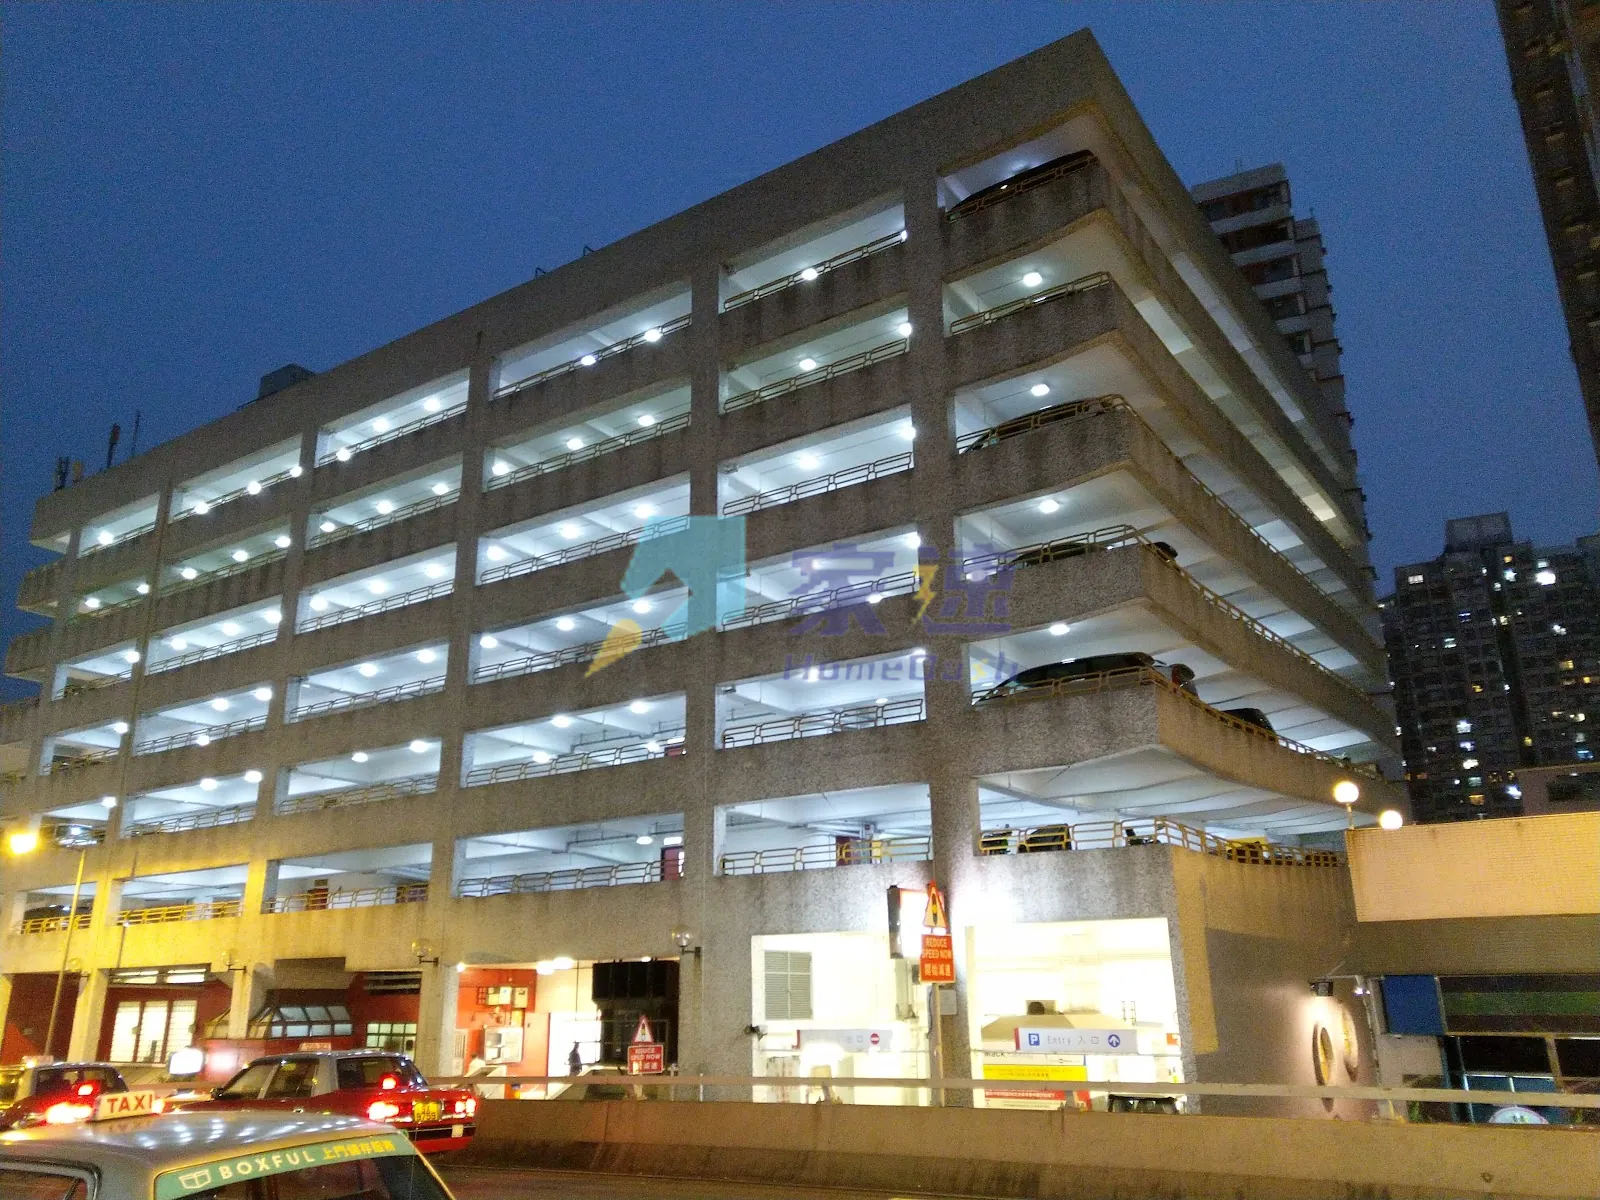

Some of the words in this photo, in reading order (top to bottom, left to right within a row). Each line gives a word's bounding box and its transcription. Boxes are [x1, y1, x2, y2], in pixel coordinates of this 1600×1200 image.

[925, 937, 947, 948] REDUCE
[922, 948, 939, 959] SPEED
[1047, 1036, 1071, 1045] Entry
[1078, 1036, 1099, 1044] 入口
[107, 1096, 152, 1113] TAXI
[218, 1150, 315, 1180] BOXFUL
